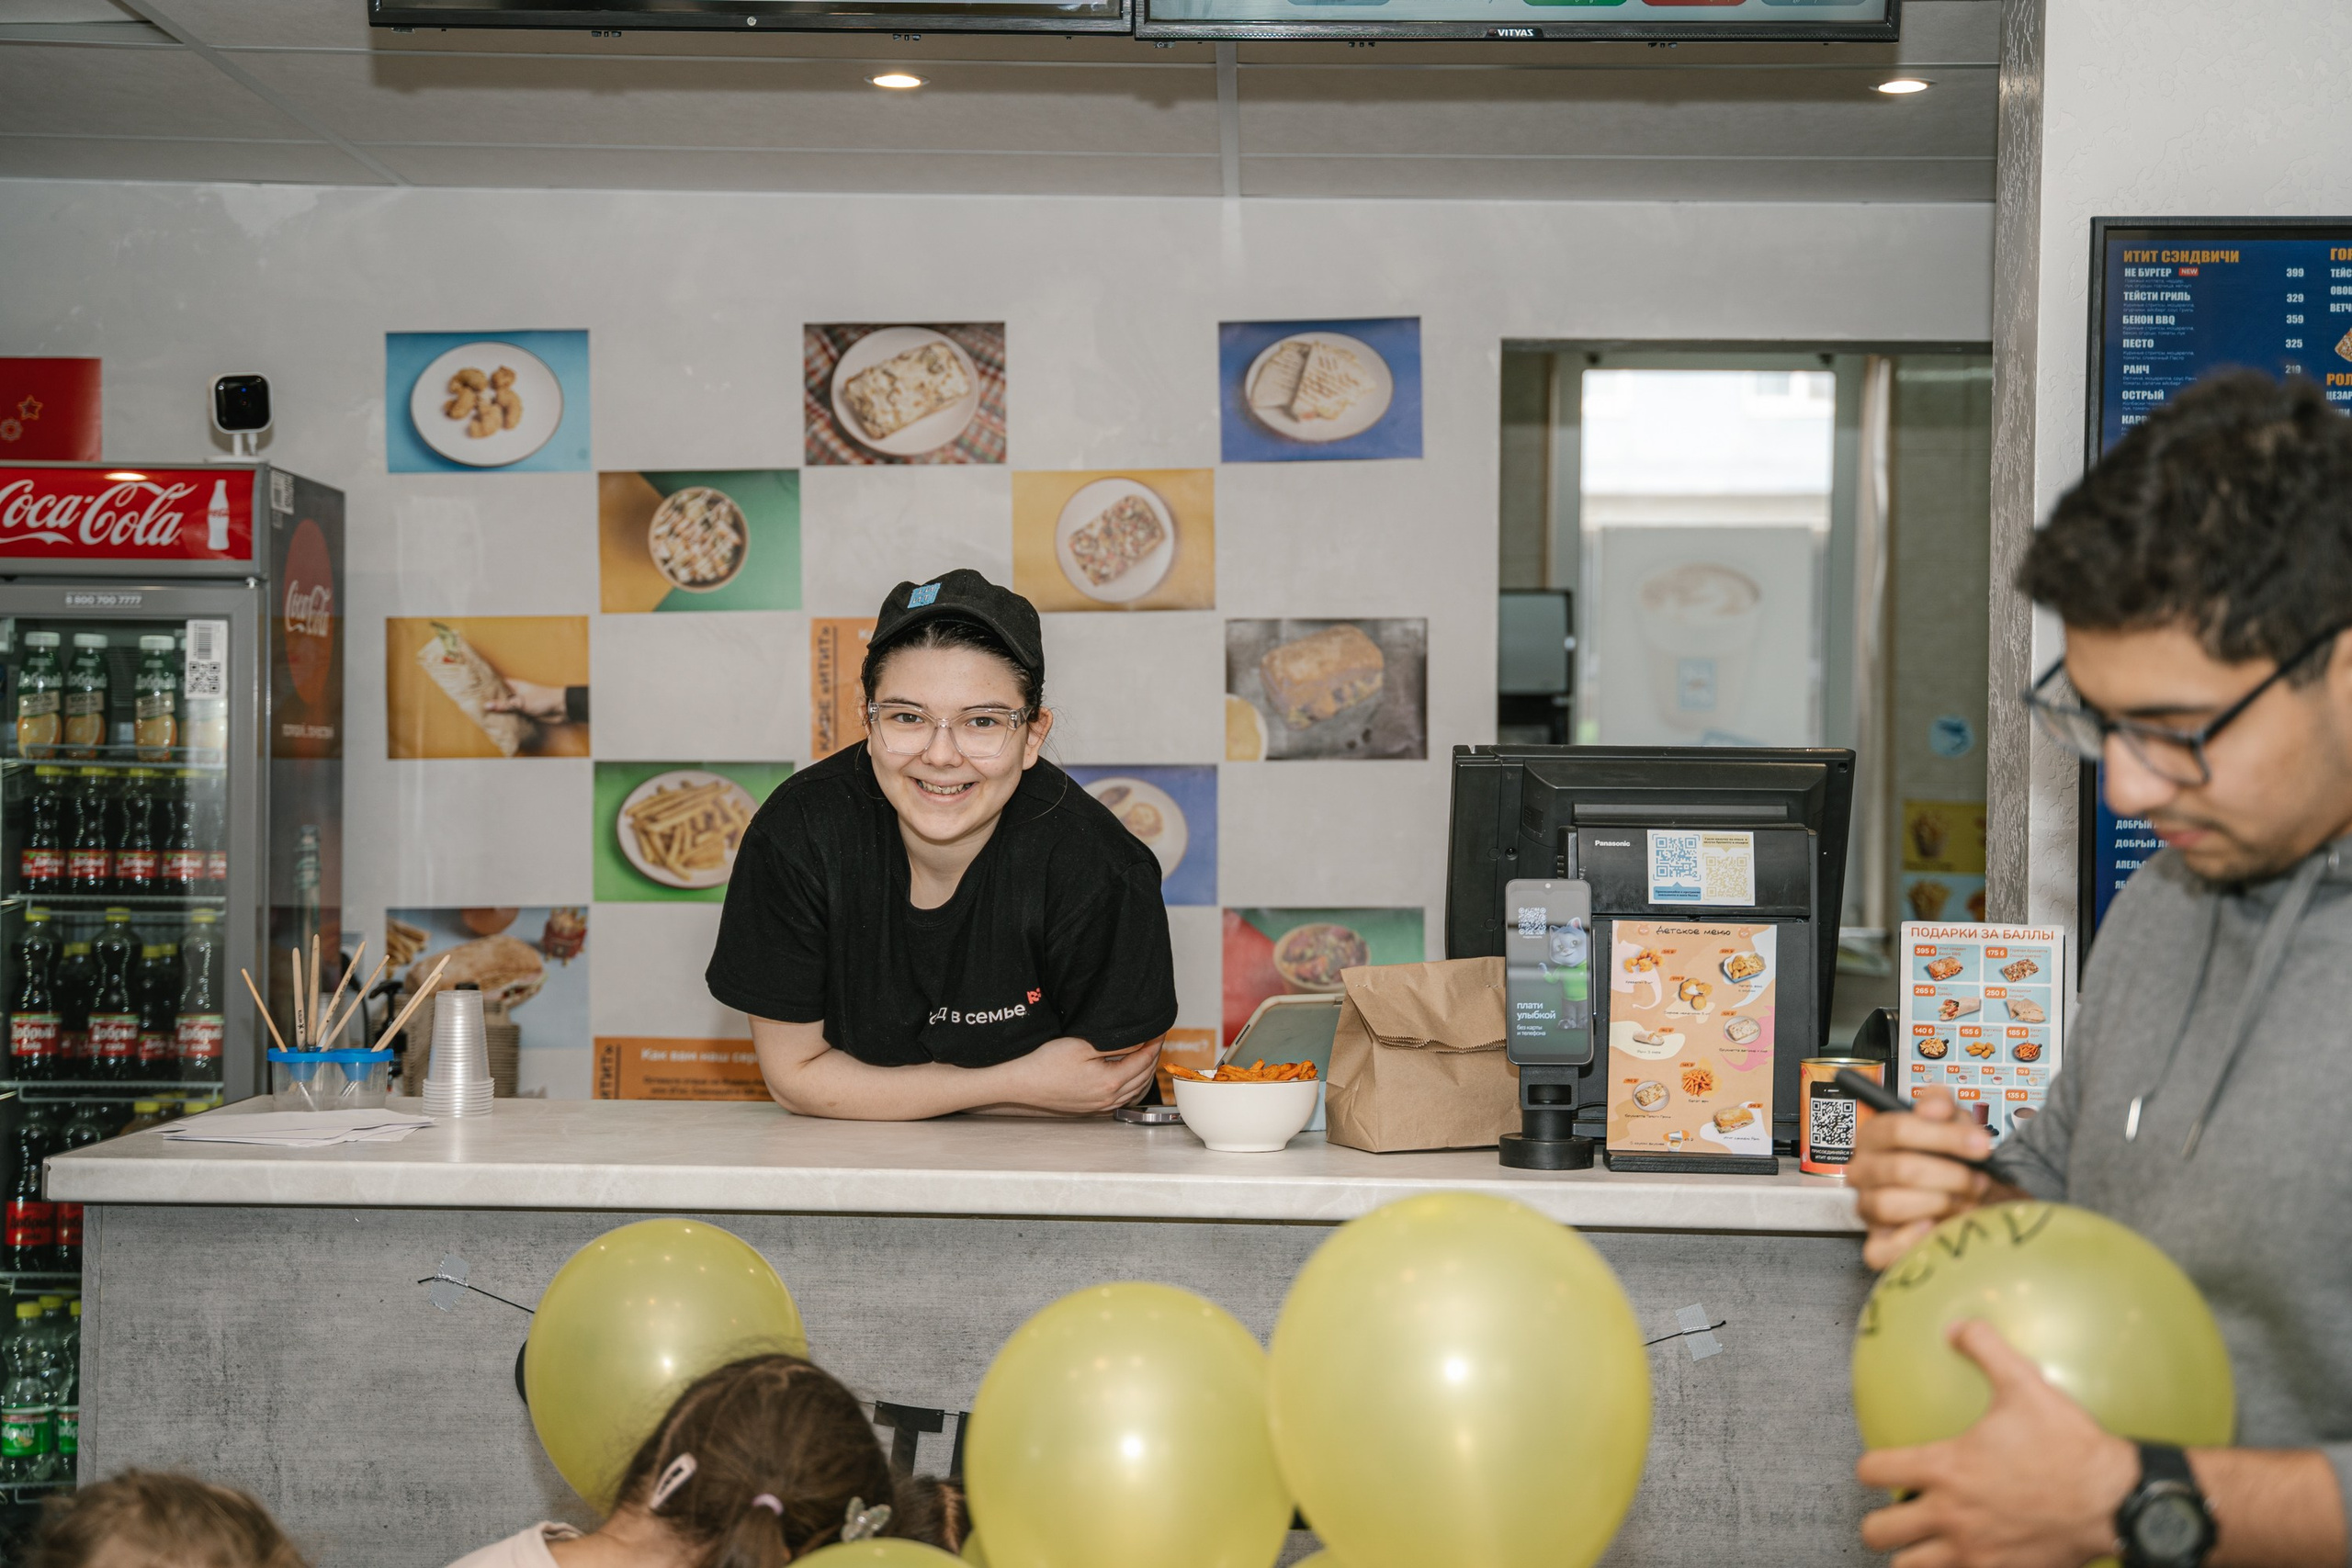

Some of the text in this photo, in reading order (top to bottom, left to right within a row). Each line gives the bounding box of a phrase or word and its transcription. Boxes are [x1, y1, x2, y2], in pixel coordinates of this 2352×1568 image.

[1498, 28, 1533, 37] VITYAS
[2123, 250, 2240, 265] ИТИТ СЭНДВИЧИ
[2124, 267, 2137, 277] НЕ
[2138, 267, 2172, 277] БУРГЕР
[2286, 267, 2304, 277] 399
[2123, 290, 2191, 301] ТЕЙСТИ ГРИЛЬ
[2286, 293, 2304, 303] 329
[2122, 315, 2176, 325] БЕКОН BBQ
[2286, 314, 2304, 324] 359
[2122, 339, 2154, 348] ПЕСТО
[2285, 339, 2303, 348] 325
[2123, 365, 2150, 374] РАНЧ
[2121, 389, 2165, 400] ОСТРЫЙ
[2121, 415, 2151, 424] КАРР
[2115, 838, 2156, 849] ДОБРЫЙ
[2115, 860, 2150, 869] АПЕЛЬС
[1656, 926, 1700, 935] Детское
[1911, 927, 2054, 941] ПОДАРКИ ЗА БАЛЛЫ
[951, 1011, 961, 1023] в
[965, 1004, 1026, 1025] семье
[1517, 1010, 1555, 1021] улыбкой
[640, 1048, 669, 1061] Как
